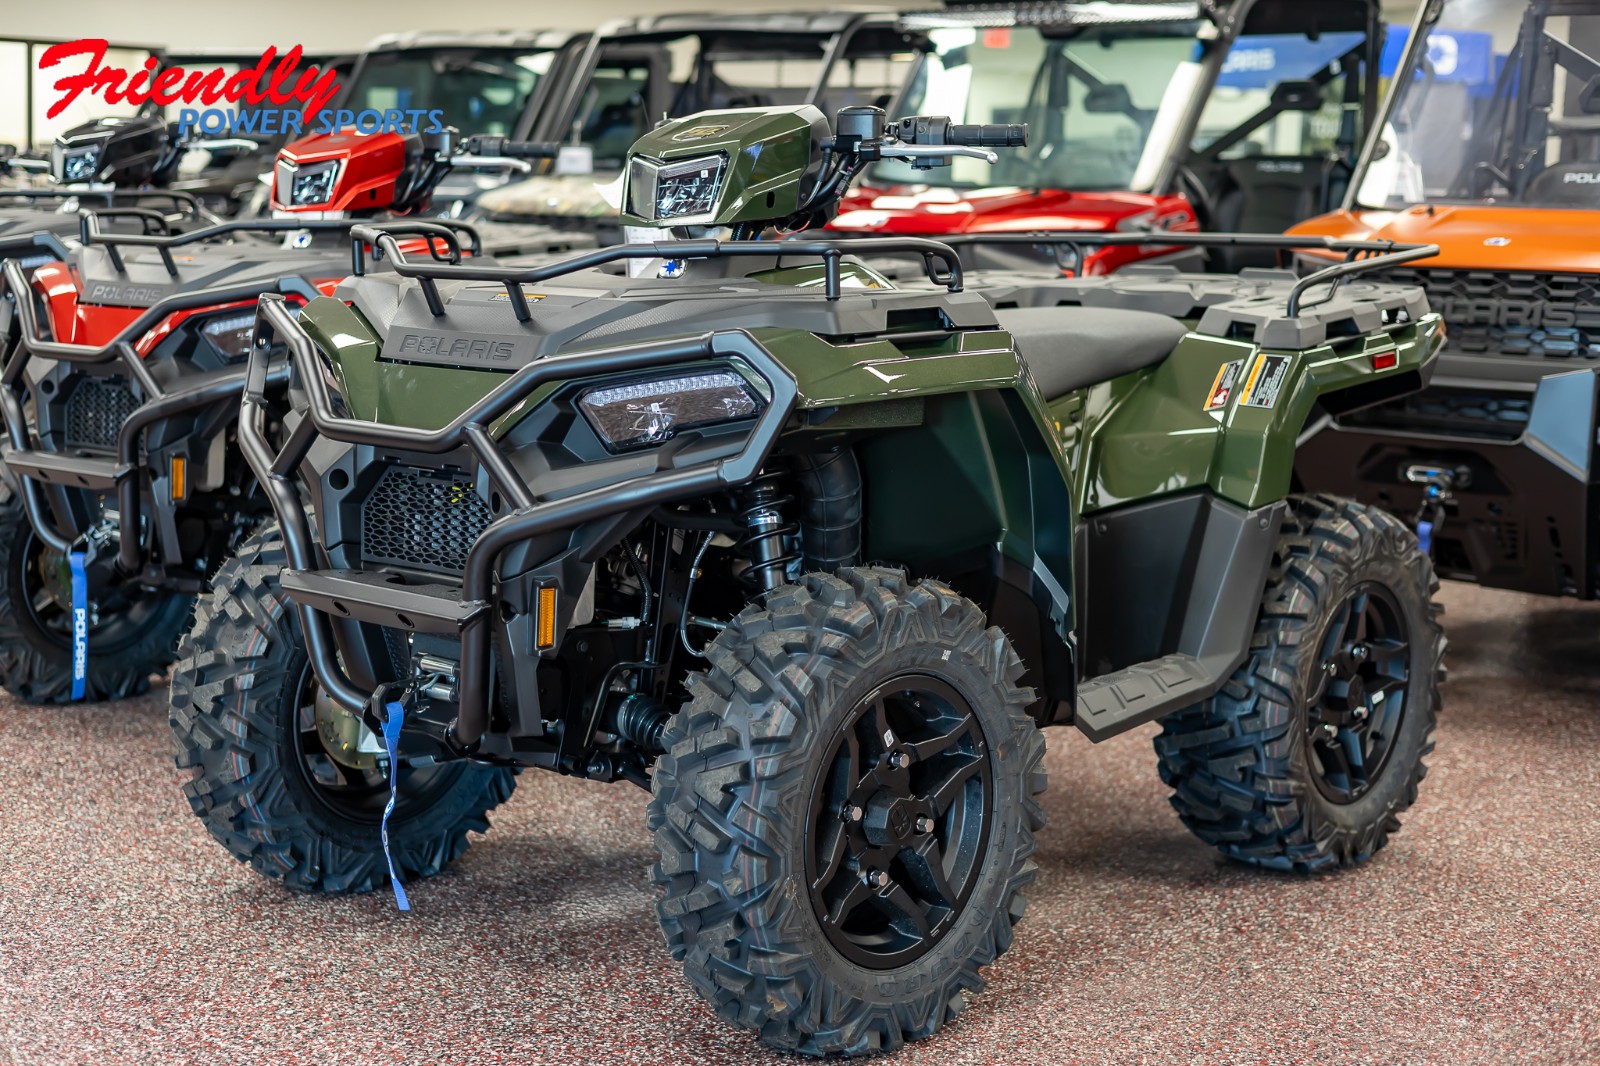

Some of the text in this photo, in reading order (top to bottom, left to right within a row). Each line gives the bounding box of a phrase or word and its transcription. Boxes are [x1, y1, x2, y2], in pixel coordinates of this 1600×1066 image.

[91, 284, 161, 301] POLARIS
[399, 334, 515, 361] POLARIS
[75, 608, 86, 680] POLARIS
